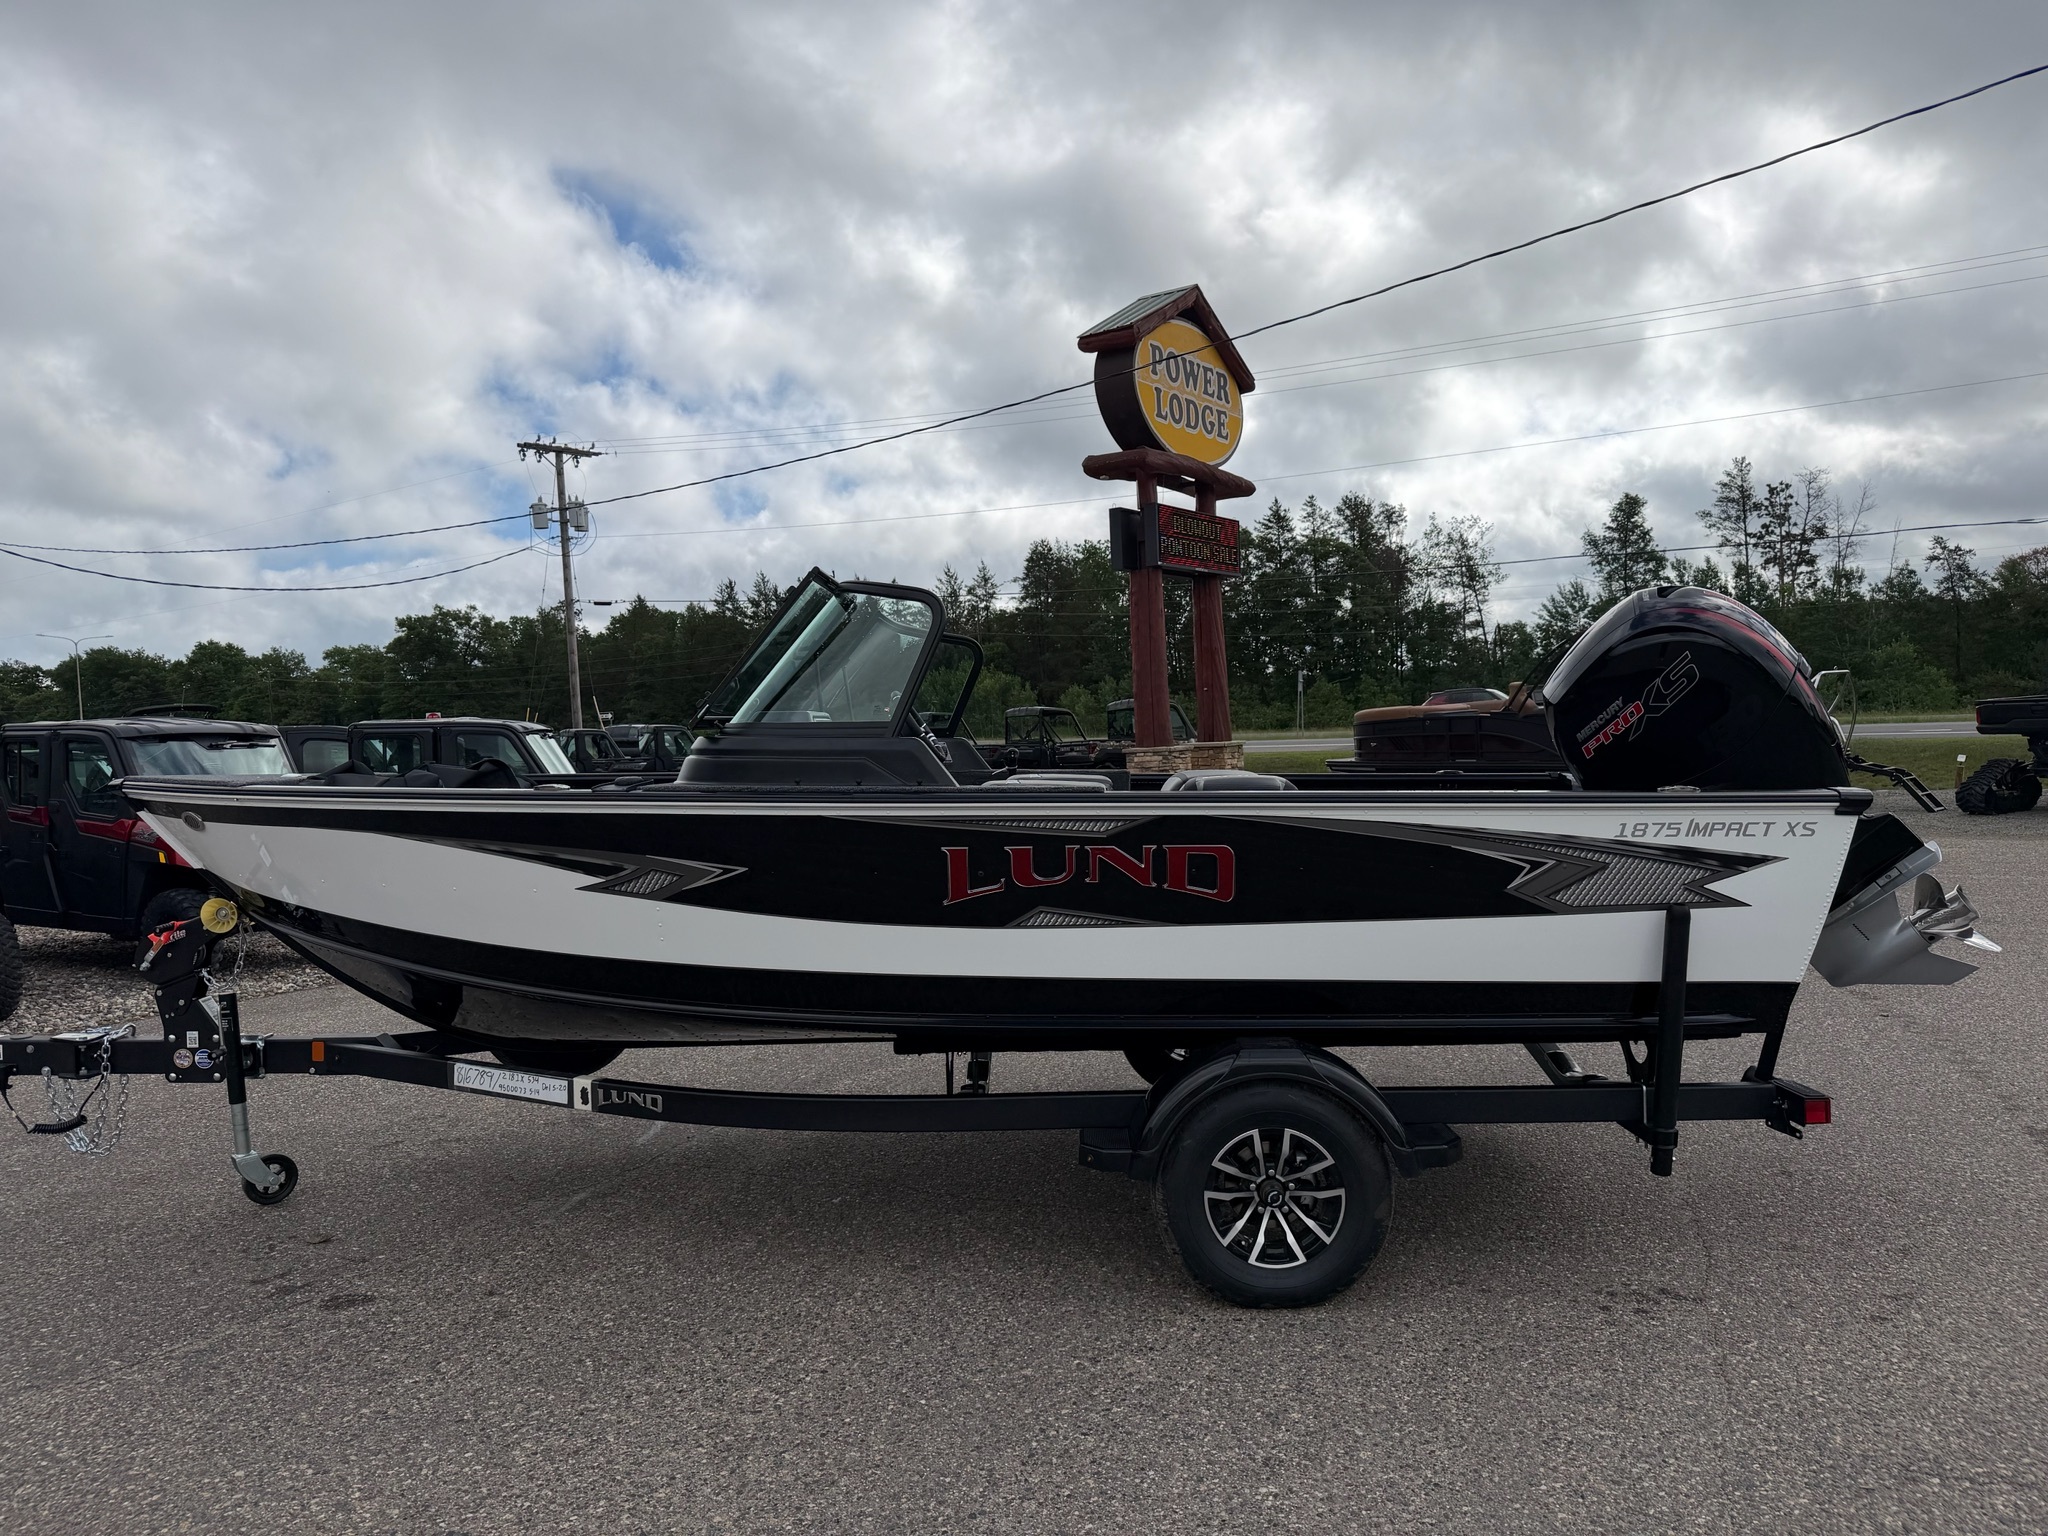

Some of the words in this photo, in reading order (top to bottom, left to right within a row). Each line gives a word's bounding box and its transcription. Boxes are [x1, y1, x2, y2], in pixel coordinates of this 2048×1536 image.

[1149, 342, 1231, 405] POWER
[1153, 386, 1230, 442] LODGE
[1160, 536, 1211, 560] PONTOON
[1212, 545, 1238, 565] SALE
[1173, 515, 1222, 540] BLOWOUT
[1575, 695, 1624, 743] MERCURY
[1581, 700, 1645, 760] PRO
[1628, 650, 1700, 743] XS
[1613, 820, 1684, 839] 1875
[1684, 818, 1777, 838] IMPACT
[1782, 820, 1819, 838] XS
[940, 844, 1236, 907] LUND
[596, 1087, 663, 1114] LUND
